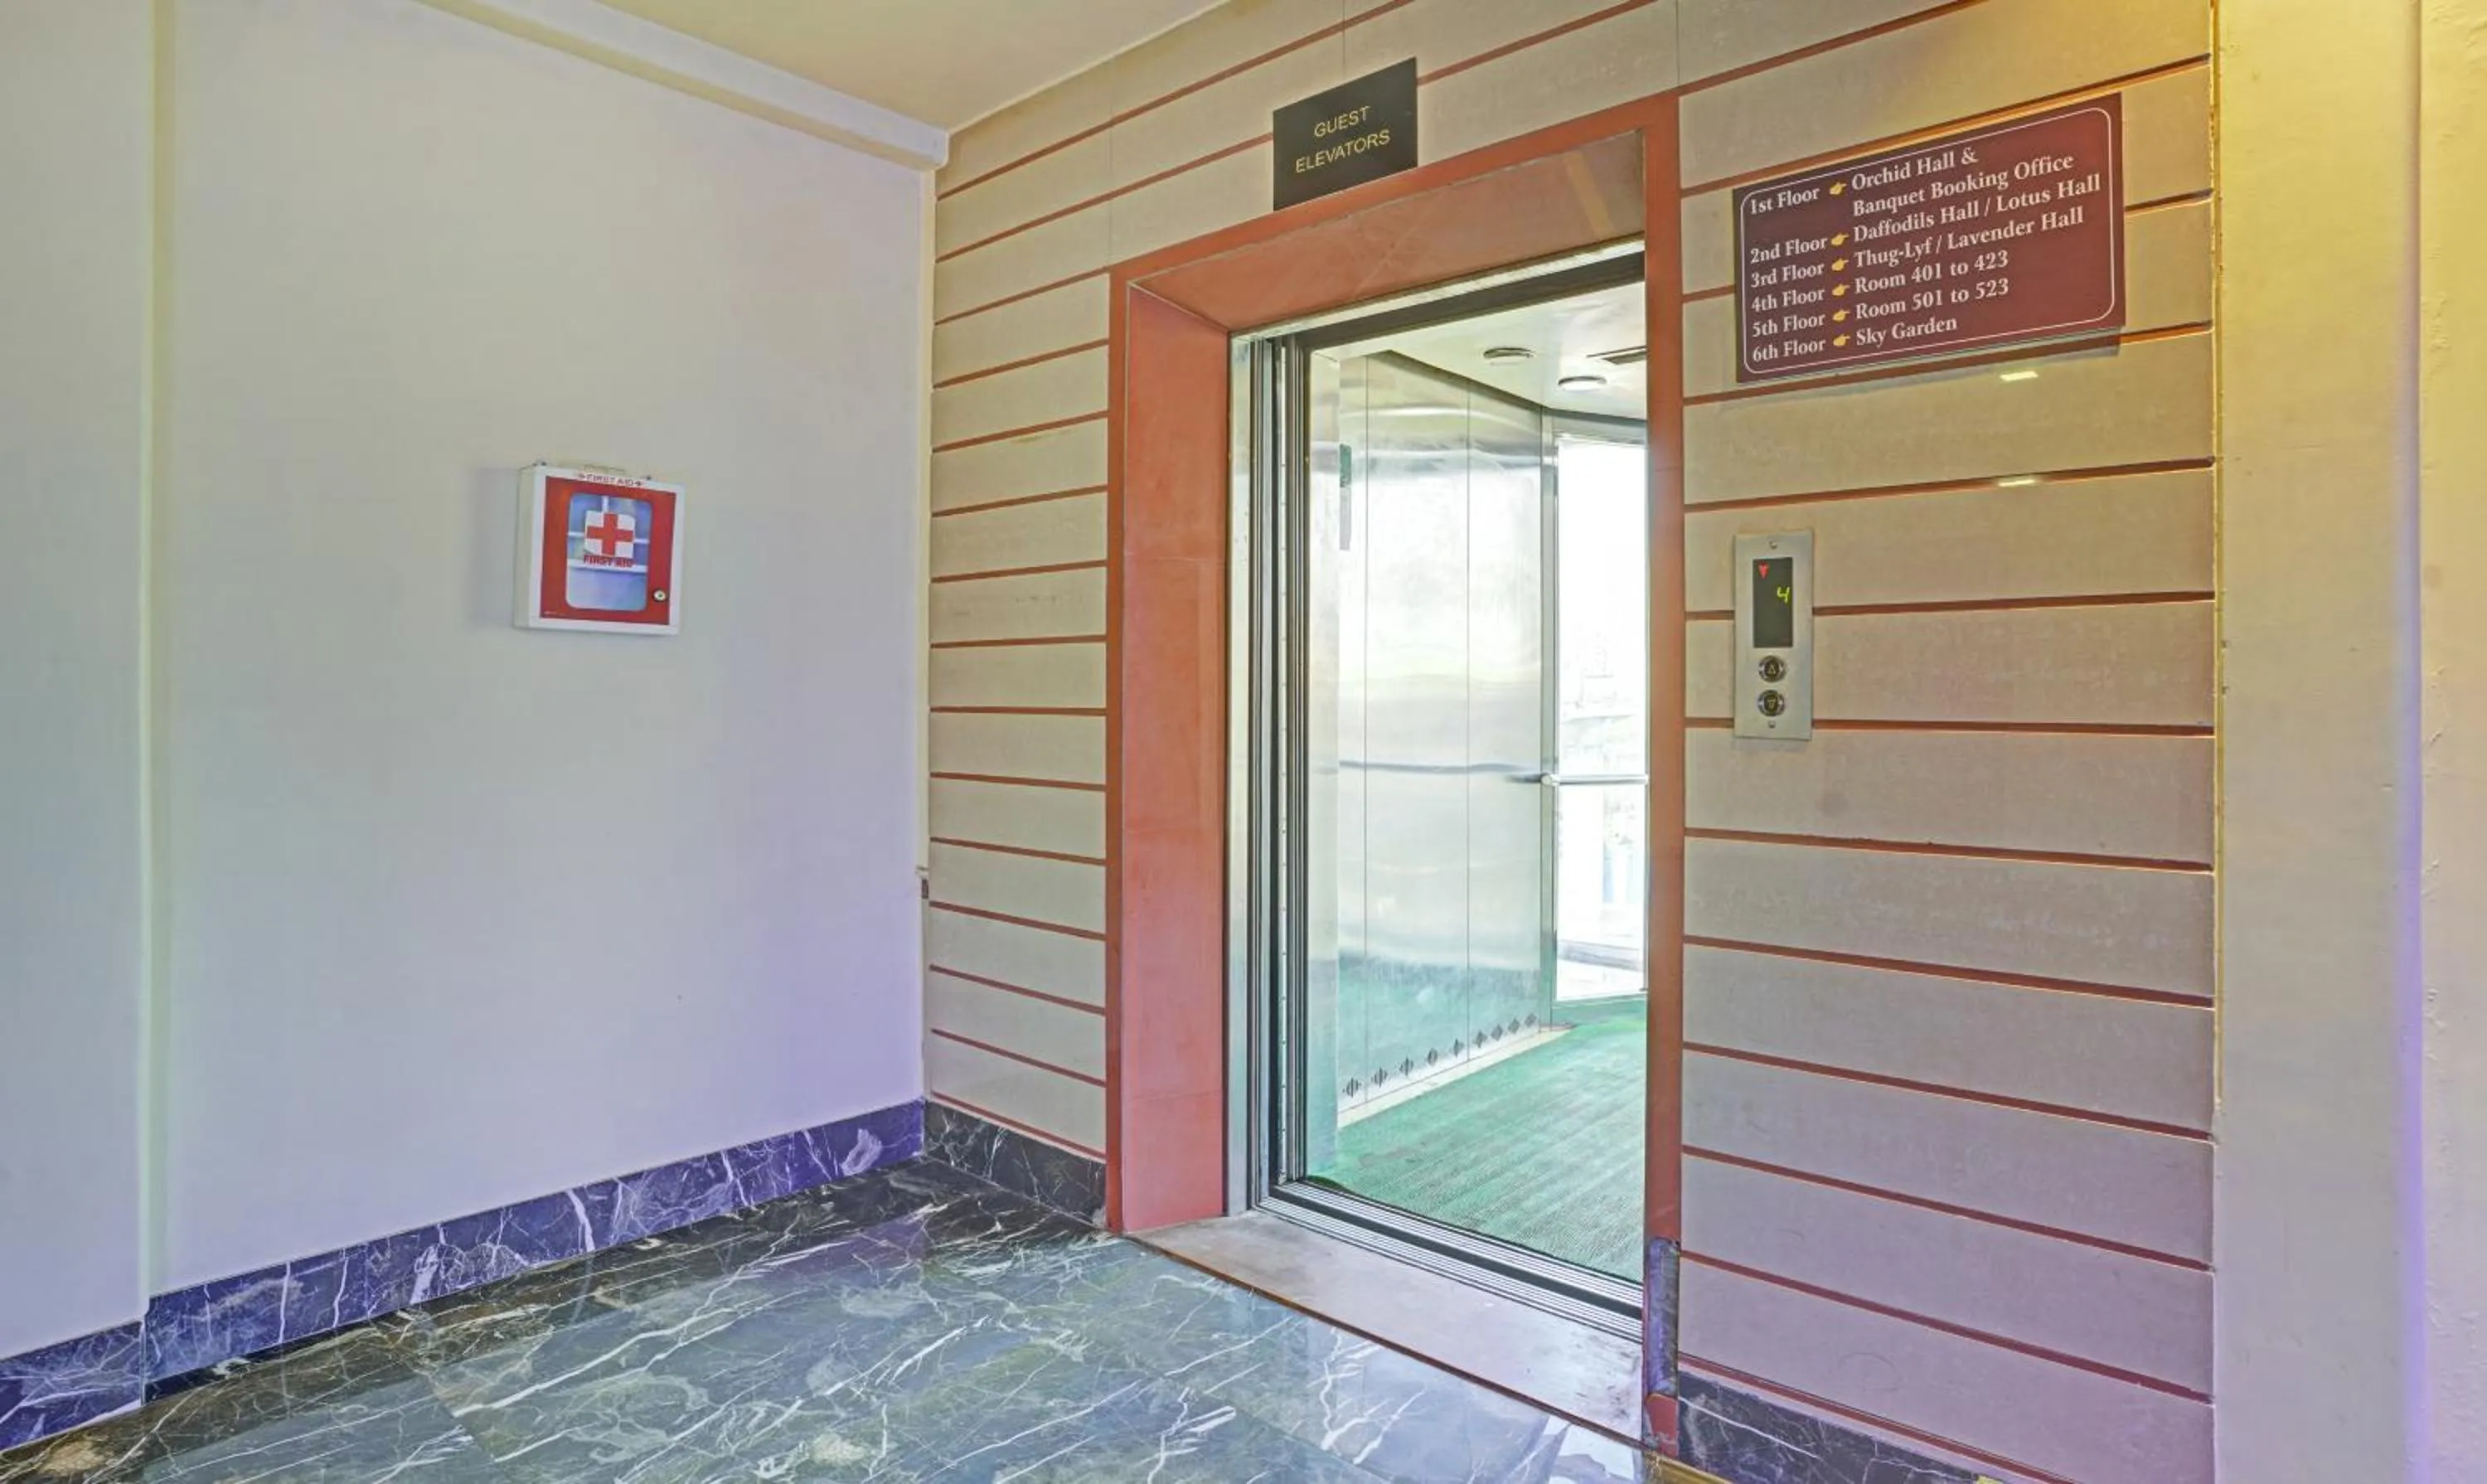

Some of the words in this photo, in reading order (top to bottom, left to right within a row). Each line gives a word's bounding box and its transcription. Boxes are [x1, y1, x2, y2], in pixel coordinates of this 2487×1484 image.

[1314, 106, 1370, 138] GUEST
[1296, 129, 1391, 173] ELEVATORS
[1750, 198, 1773, 215] 1st
[1777, 187, 1820, 207] Floor
[1851, 162, 1910, 191] Orchid
[1917, 155, 1955, 176] Hall
[1961, 147, 1978, 165] &
[1853, 188, 1926, 217] Banquet
[1932, 171, 2009, 200] Booking
[2014, 155, 2074, 181] Office
[1751, 244, 1781, 264] 2nd
[1785, 236, 1827, 256] Floor
[1854, 211, 1935, 242] Daffodils
[1941, 201, 1980, 223] Hall
[1984, 196, 1990, 217] /
[1997, 191, 2052, 212] Lotus
[2058, 174, 2101, 199] Hall
[1751, 268, 1779, 288] 3rd
[1782, 263, 1825, 281] Floor
[1854, 237, 1932, 268] Thug-Lyf
[1937, 235, 1943, 255] /
[1947, 221, 2034, 250] Lavender
[2042, 206, 2084, 230] Hall
[1752, 294, 1778, 313] 4th
[1782, 288, 1825, 307] Floor
[1854, 274, 1906, 294] Room
[1911, 263, 1942, 282] 401
[1950, 260, 1969, 276] to
[1973, 250, 2009, 270] 423
[1752, 318, 1779, 337] 5th
[1783, 313, 1825, 332] Floor
[1855, 300, 1907, 320] Room
[1912, 289, 1943, 309] 501
[1951, 288, 1970, 303] to
[1975, 278, 2009, 298] 523
[1752, 346, 1780, 362] 6th
[1783, 337, 1826, 357] Floor
[1855, 327, 1888, 347] Sky
[1892, 316, 1957, 340] Garden
[586, 473, 615, 484] FIRST
[584, 555, 612, 567] FIRST
[616, 557, 634, 568] AID
[1777, 586, 1791, 604] 4
